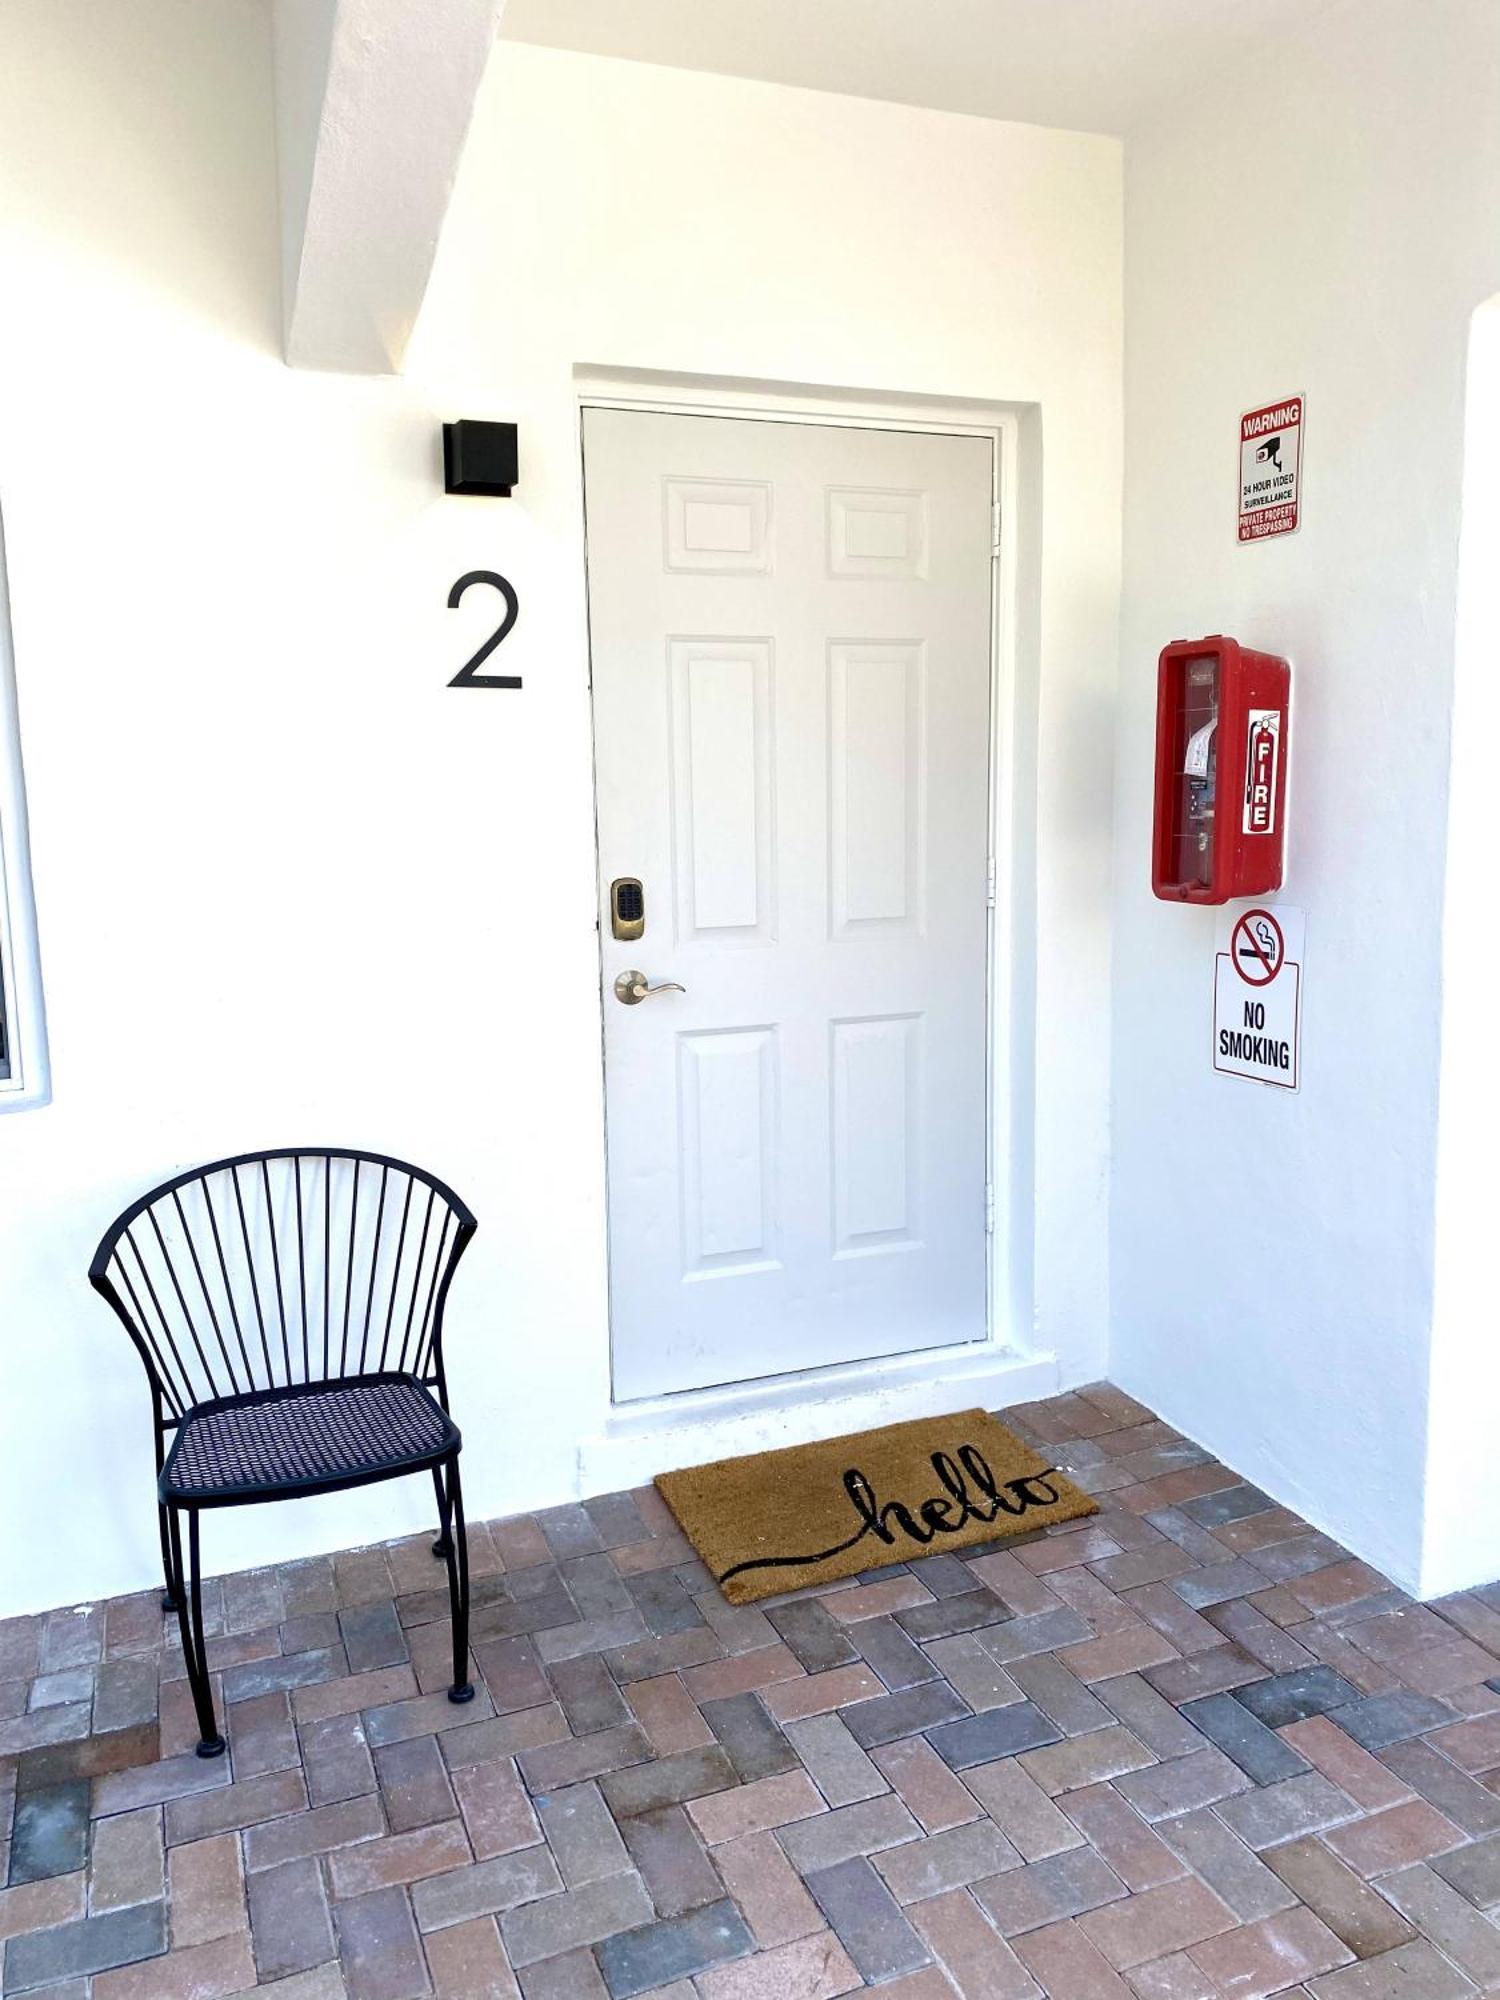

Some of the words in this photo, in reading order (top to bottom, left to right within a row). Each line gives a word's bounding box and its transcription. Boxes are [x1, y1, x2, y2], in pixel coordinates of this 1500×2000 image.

[1243, 404, 1299, 437] WARNING
[1243, 484, 1251, 496] 24
[1252, 479, 1271, 492] HOUR
[1273, 473, 1294, 487] VIDEO
[1244, 489, 1293, 509] SURVEILLANCE
[1239, 512, 1264, 527] PRIVATE
[1264, 503, 1297, 521] PROPERTY
[1241, 526, 1250, 538] NO
[1250, 516, 1293, 537] TRESPASSING
[446, 570, 522, 689] 2
[1253, 742, 1270, 826] FIRE
[1243, 1001, 1265, 1030] NO
[1219, 1029, 1290, 1070] SMOKING
